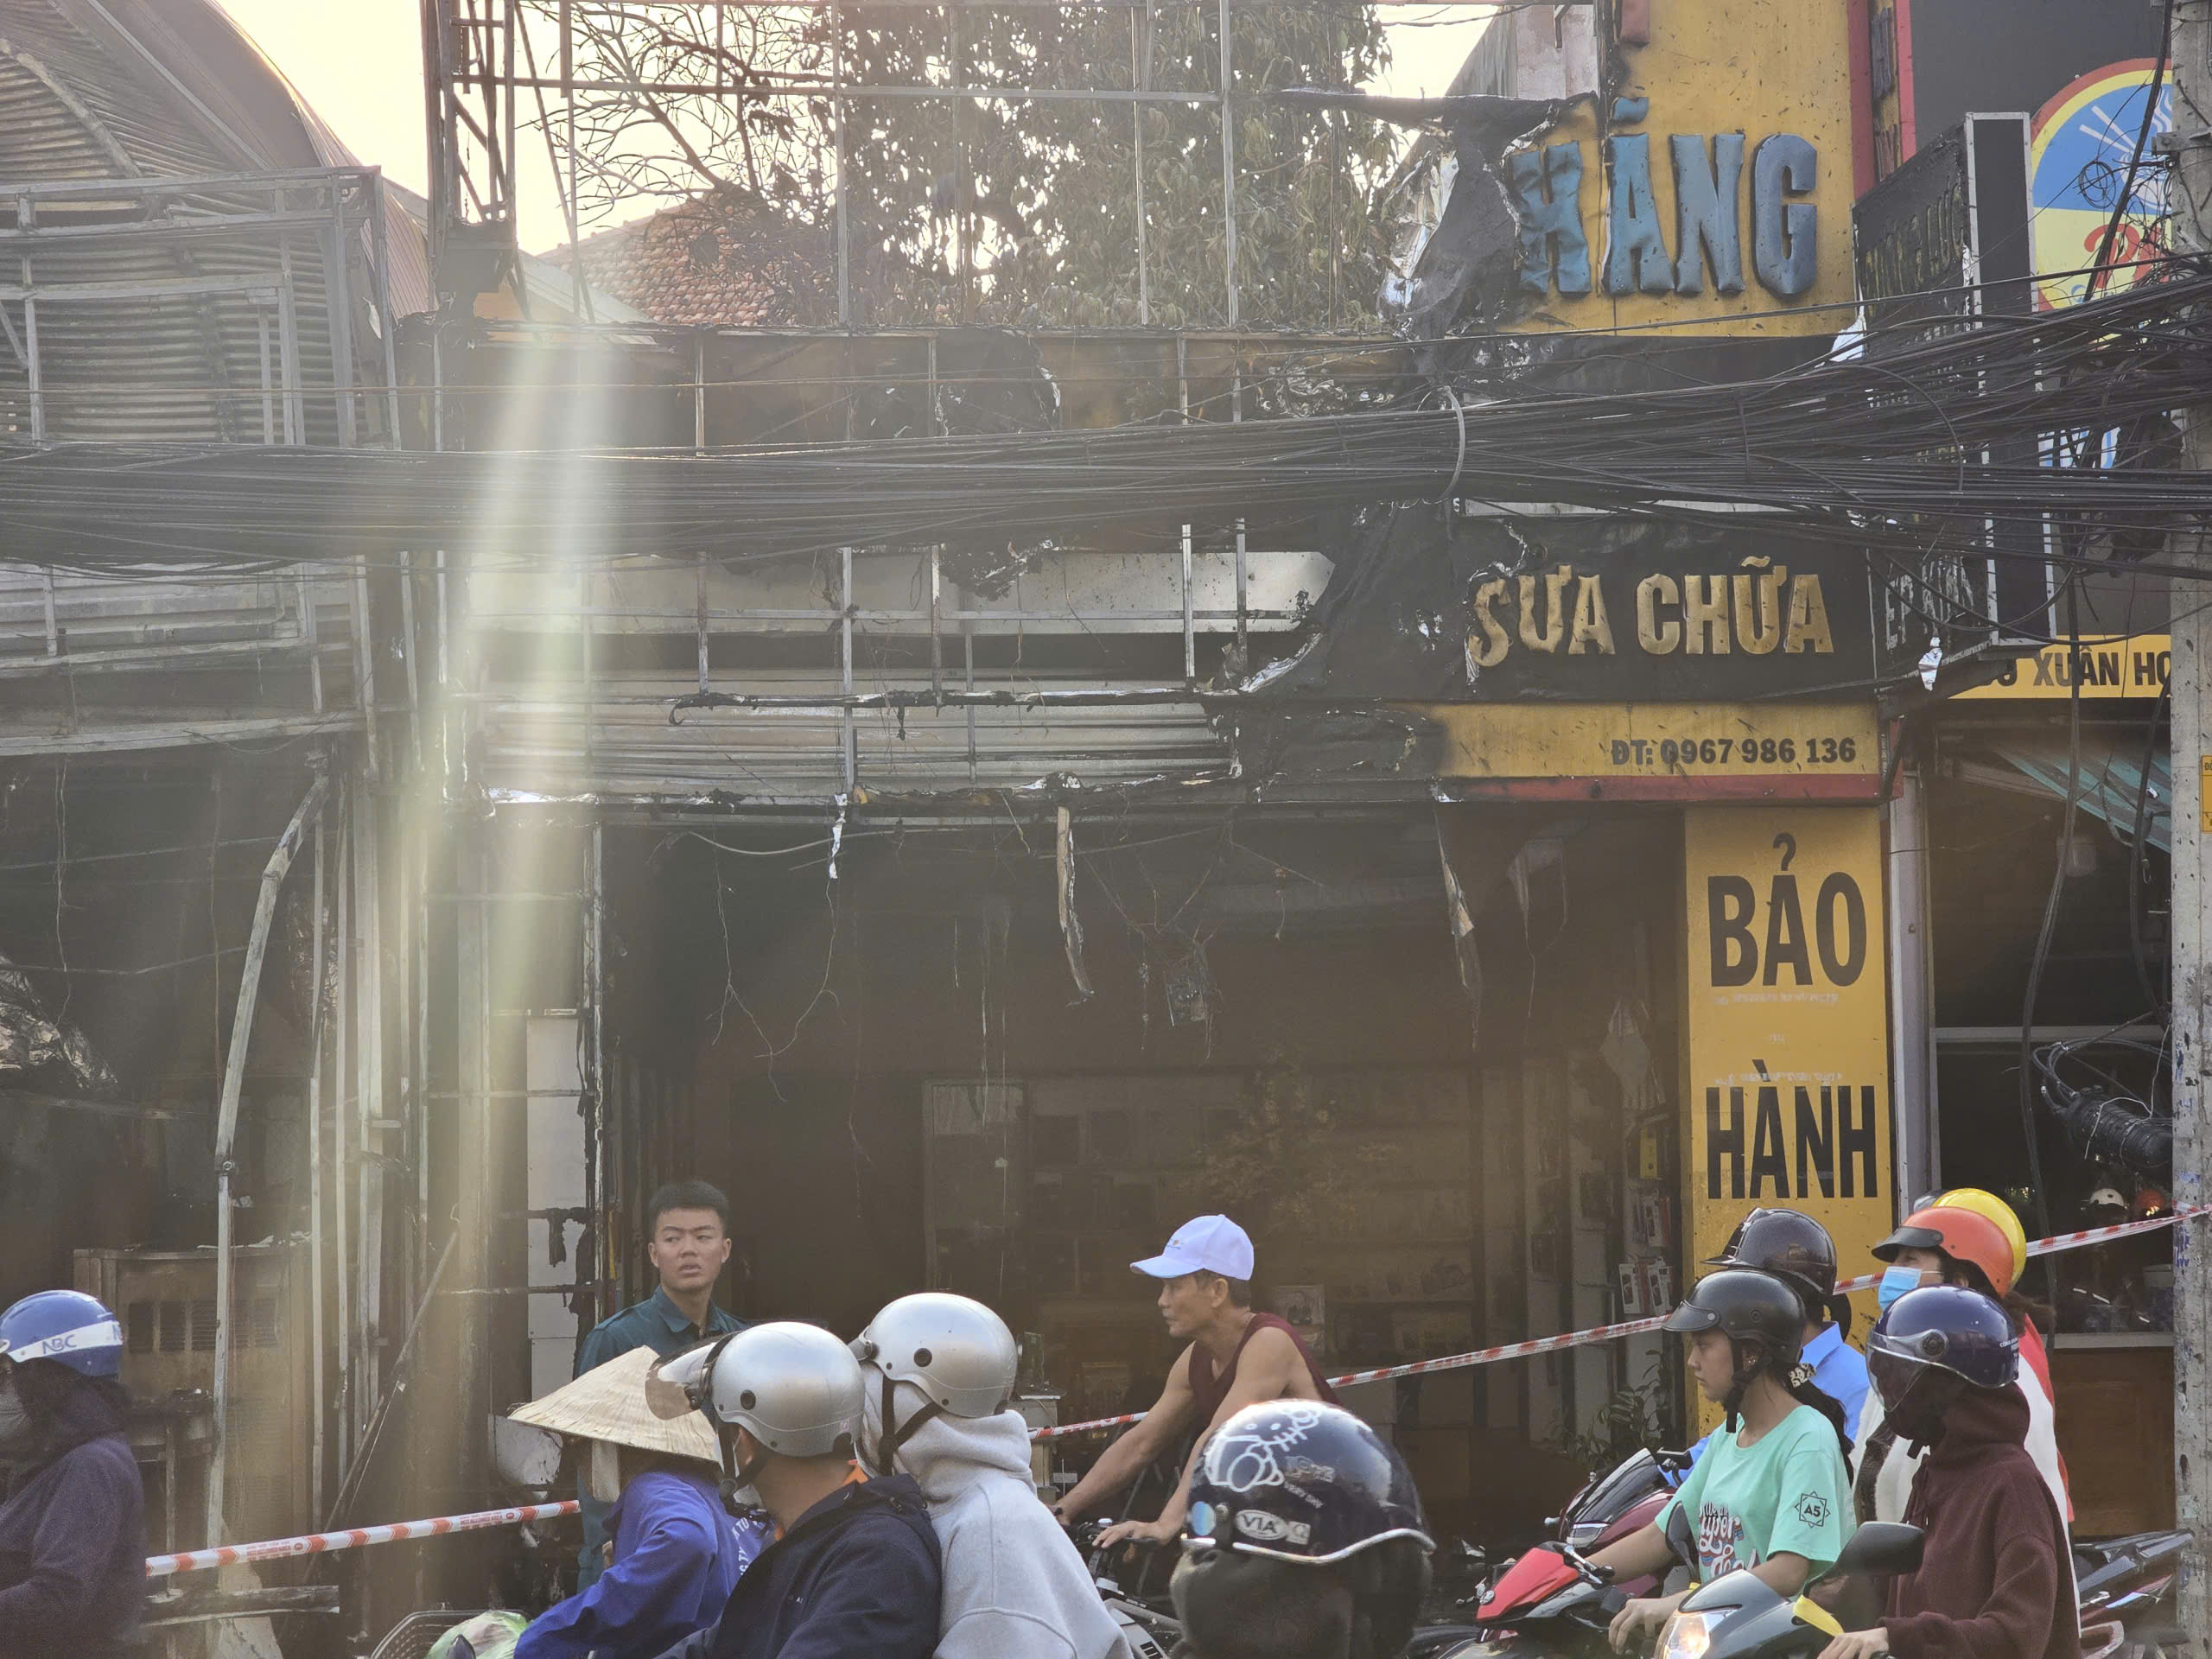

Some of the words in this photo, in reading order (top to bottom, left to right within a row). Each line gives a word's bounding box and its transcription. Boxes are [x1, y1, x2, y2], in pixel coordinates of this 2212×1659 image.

[1637, 556, 1834, 654] CHỮA
[2032, 645, 2120, 686] XUÂN
[1611, 739, 1653, 766] ĐT:
[1660, 739, 1733, 764] 0967
[1741, 738, 1796, 763] 986
[1806, 738, 1856, 764] 136
[1707, 832, 1867, 987] BẢO
[1706, 1059, 1878, 1198] HÀNH
[1804, 1503, 1821, 1517] A5
